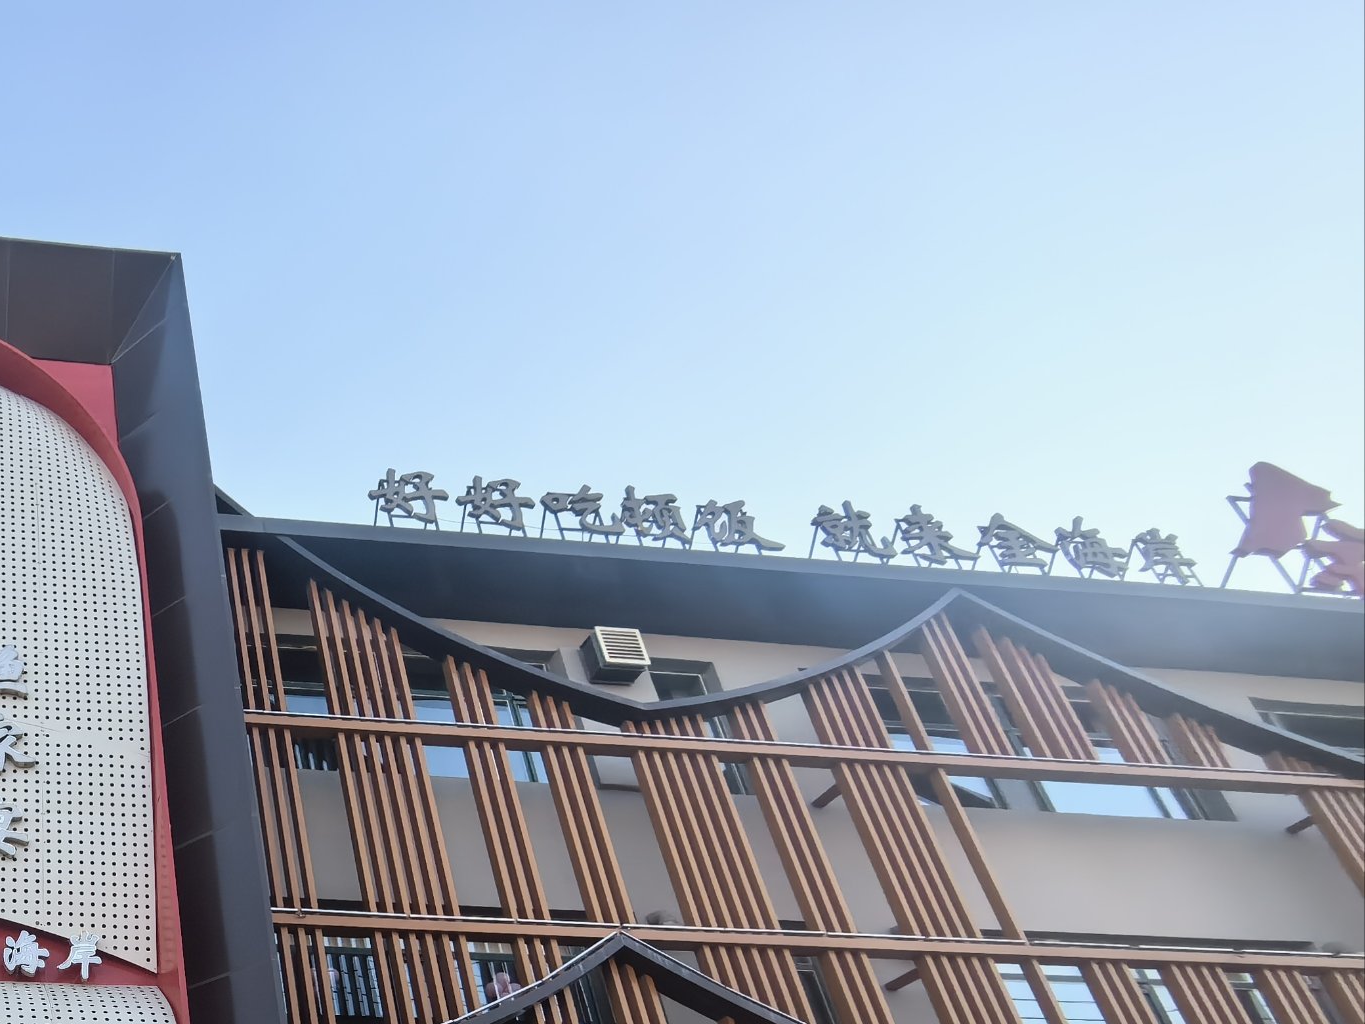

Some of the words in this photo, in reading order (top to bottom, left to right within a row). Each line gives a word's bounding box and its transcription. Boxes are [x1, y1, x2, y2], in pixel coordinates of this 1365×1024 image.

[368, 468, 786, 551] 好好吃顿饭
[811, 500, 1196, 586] 就来金海岸
